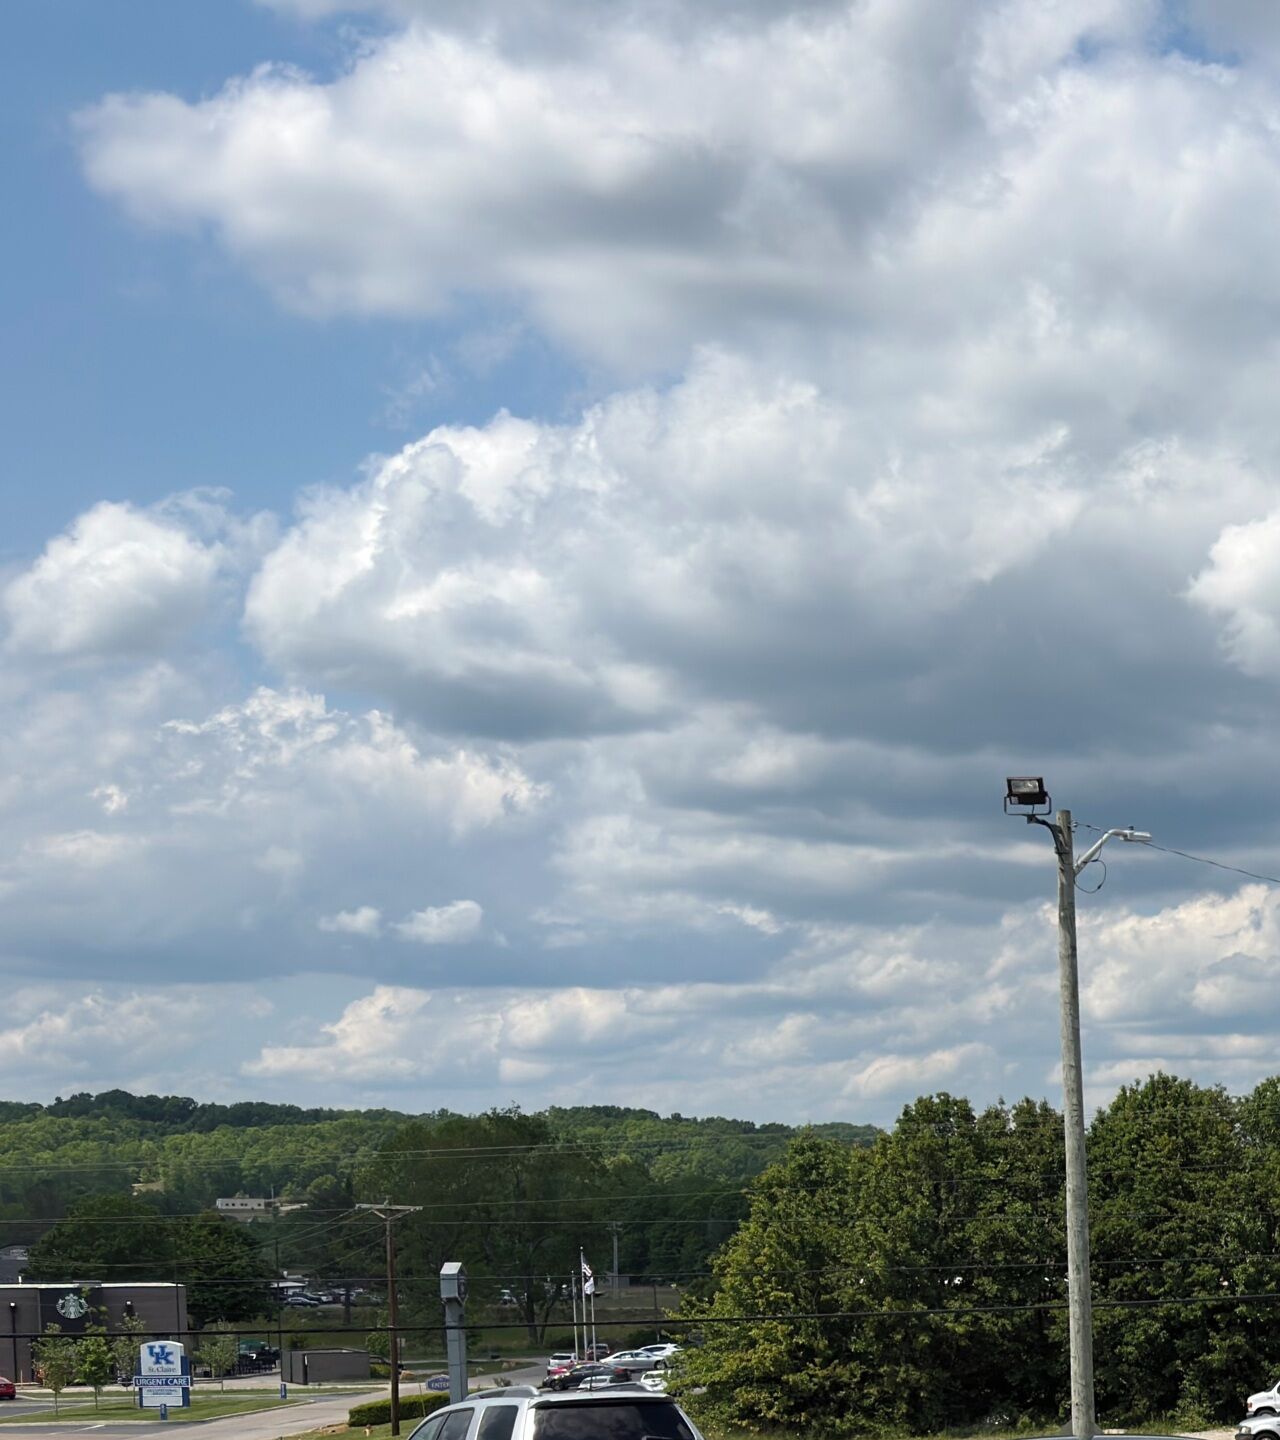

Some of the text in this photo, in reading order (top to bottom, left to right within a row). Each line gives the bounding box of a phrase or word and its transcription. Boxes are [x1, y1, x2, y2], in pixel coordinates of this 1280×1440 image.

[147, 1344, 174, 1365] UK
[136, 1378, 188, 1386] URGENT CARE
